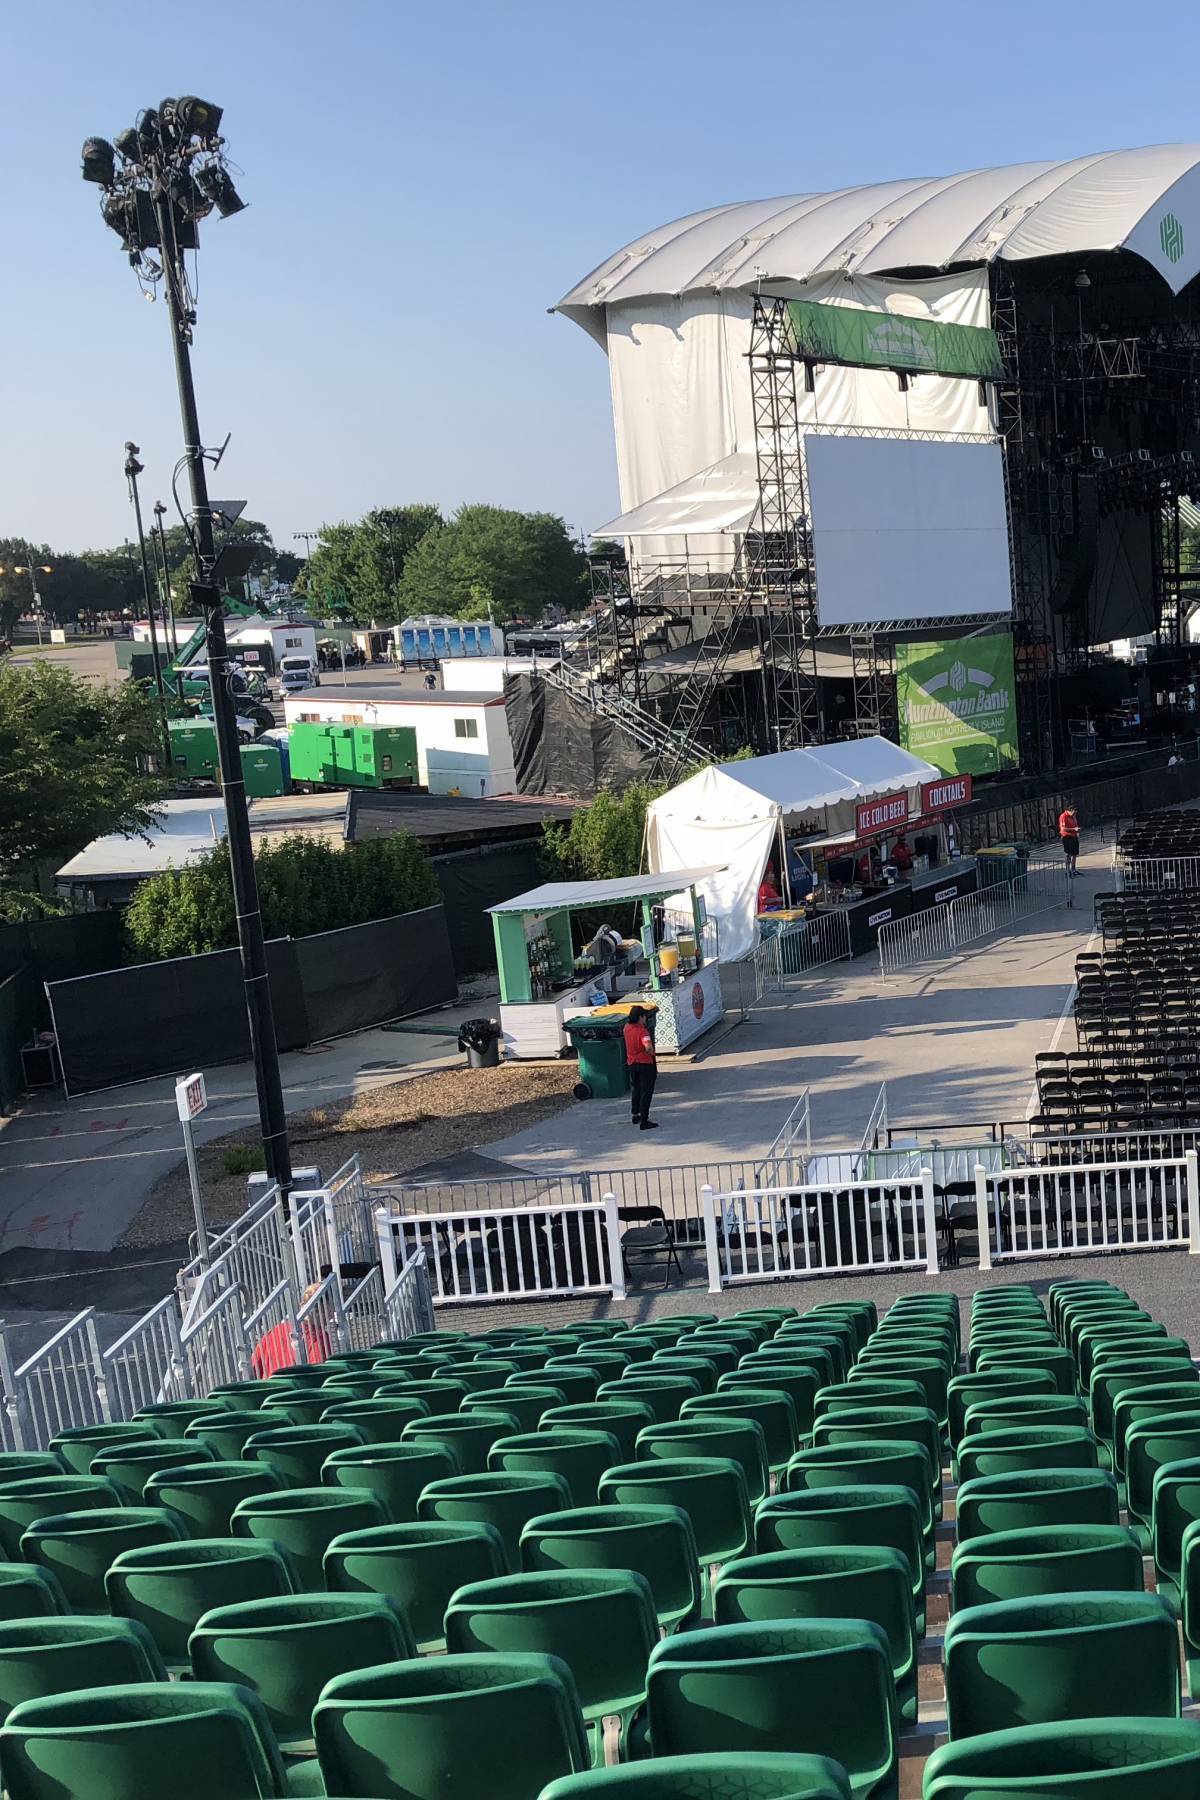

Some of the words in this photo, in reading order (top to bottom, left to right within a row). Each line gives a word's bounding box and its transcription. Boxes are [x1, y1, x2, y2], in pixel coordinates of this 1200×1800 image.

[905, 698, 976, 724] Huntington
[976, 688, 1009, 713] Bank
[981, 717, 1005, 730] ISLAND
[929, 781, 966, 808] COCKTAILS
[859, 811, 870, 831] ICE
[871, 804, 888, 826] COLD
[889, 799, 905, 820] BEER
[186, 1079, 203, 1110] EXIT
